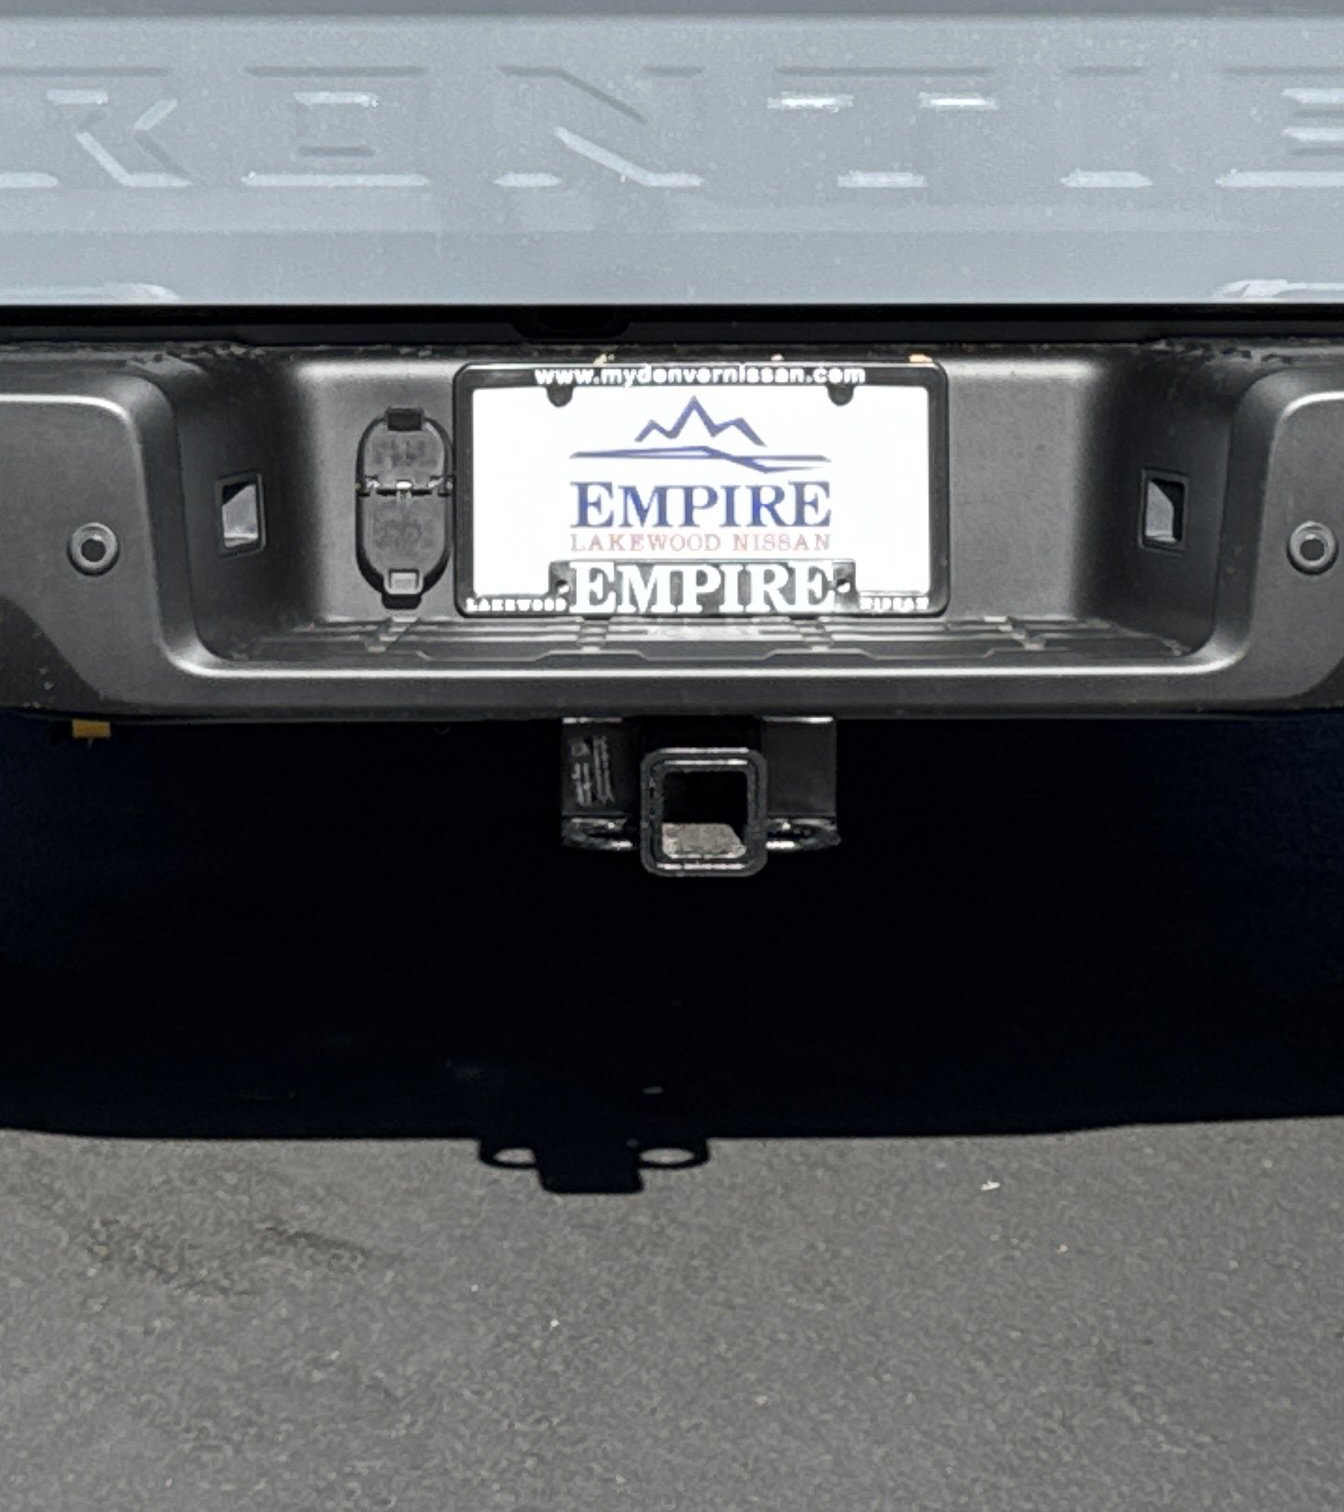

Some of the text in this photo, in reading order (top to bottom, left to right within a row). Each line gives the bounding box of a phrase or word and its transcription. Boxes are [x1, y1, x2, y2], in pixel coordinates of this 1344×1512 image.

[534, 364, 866, 387] www.mydenvernissan.com
[570, 481, 832, 528] EMPIRE
[570, 533, 831, 552] LAKEWOOD NISSAN
[568, 560, 836, 614] EMPIRE
